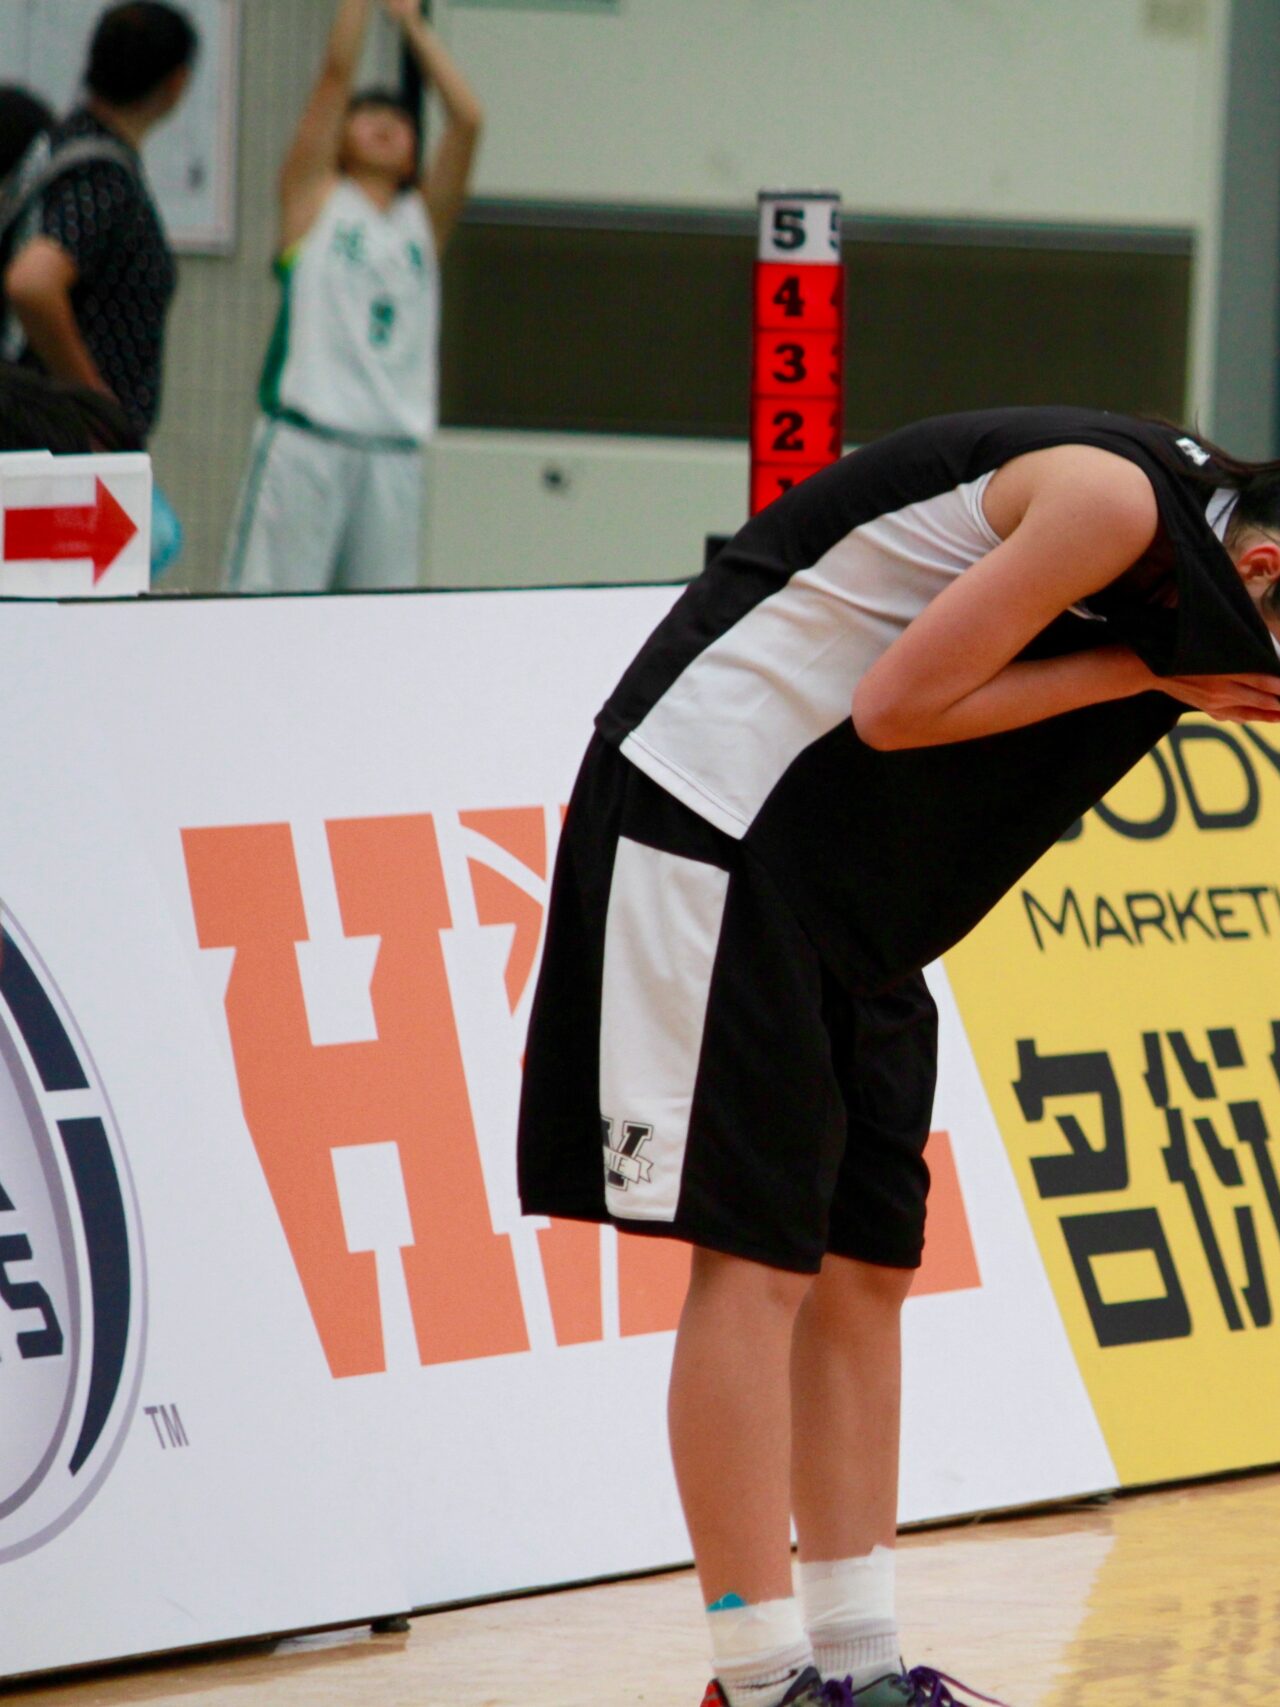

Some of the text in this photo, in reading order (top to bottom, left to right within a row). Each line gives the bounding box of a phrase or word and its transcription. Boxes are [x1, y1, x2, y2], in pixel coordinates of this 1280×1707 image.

[772, 206, 806, 251] 5
[773, 275, 805, 318] 4
[772, 342, 807, 384] 3
[772, 409, 804, 453] 2
[143, 1402, 191, 1451] TM
